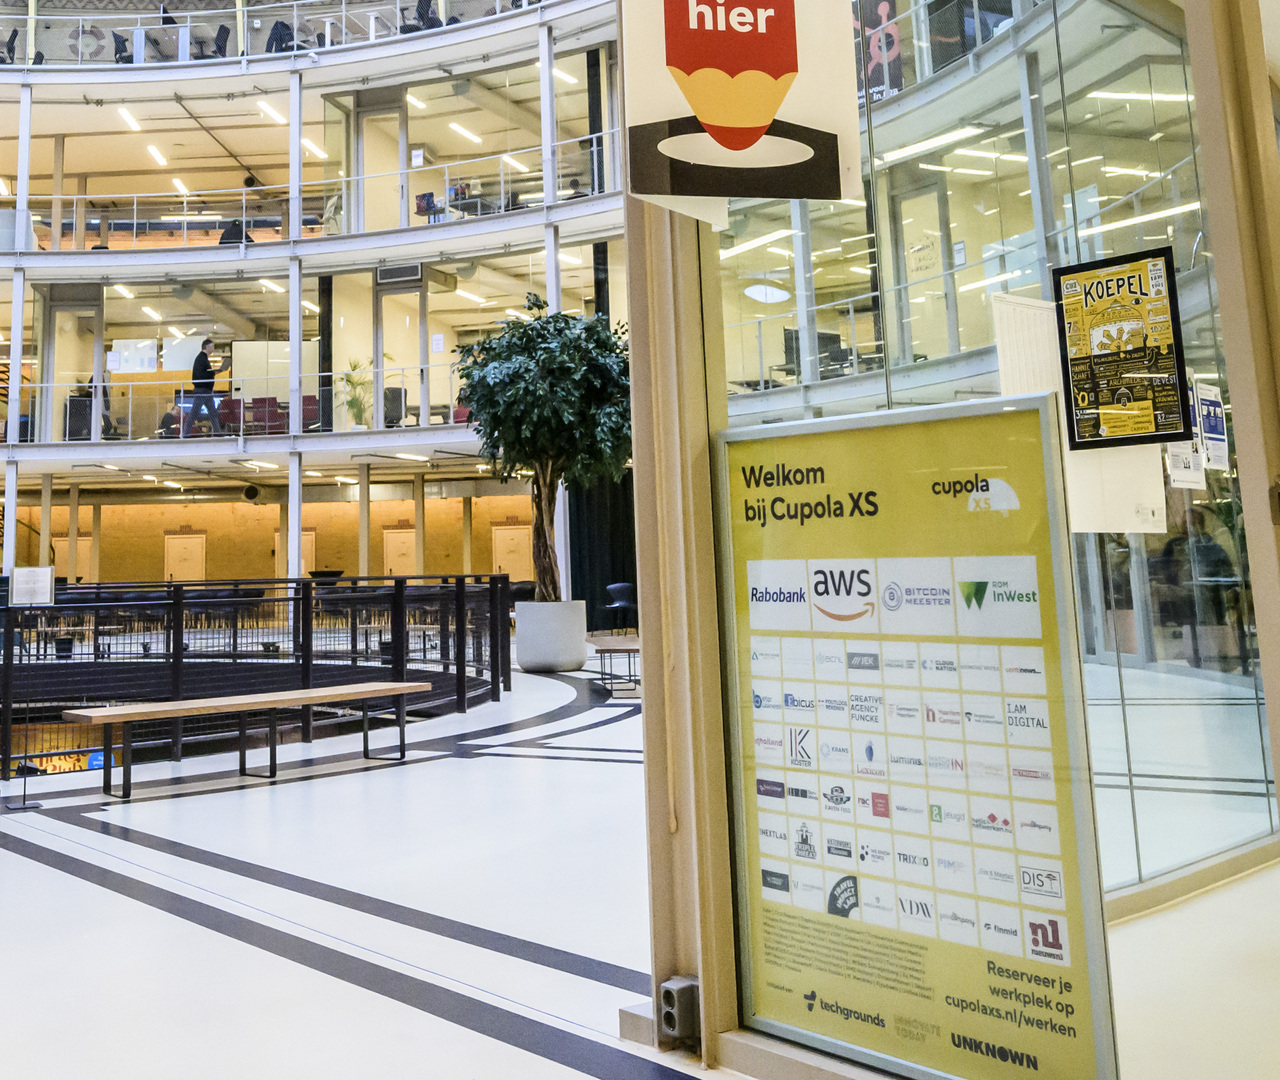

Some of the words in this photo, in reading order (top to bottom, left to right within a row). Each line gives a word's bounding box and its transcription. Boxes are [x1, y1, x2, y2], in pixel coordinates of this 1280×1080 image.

[1083, 274, 1149, 309] KOEPEL
[742, 463, 825, 489] Welkom
[931, 473, 990, 498] cupola
[745, 500, 767, 527] bij
[770, 493, 844, 526] Cupola
[849, 491, 879, 517] XS
[973, 497, 991, 511] XS
[813, 569, 871, 597] aws
[905, 588, 950, 597] BITCOIN
[751, 587, 806, 603] Rabobank
[905, 597, 951, 606] MEESTER
[993, 590, 1037, 602] InWest
[850, 695, 883, 704] CREATIVE
[851, 714, 879, 723] FUNCKE
[1008, 716, 1048, 728] DIGITAL
[791, 759, 812, 767] KOSTER
[993, 924, 1018, 937] finmid
[987, 960, 1056, 989] Reserveer
[1059, 977, 1073, 994] je
[989, 985, 1053, 1011] werkplek
[1055, 1000, 1075, 1018] op
[820, 998, 886, 1028] techgrounds
[945, 995, 1077, 1038] cupolaxs.nl/werken
[951, 1032, 1039, 1071] UNKNOWN
